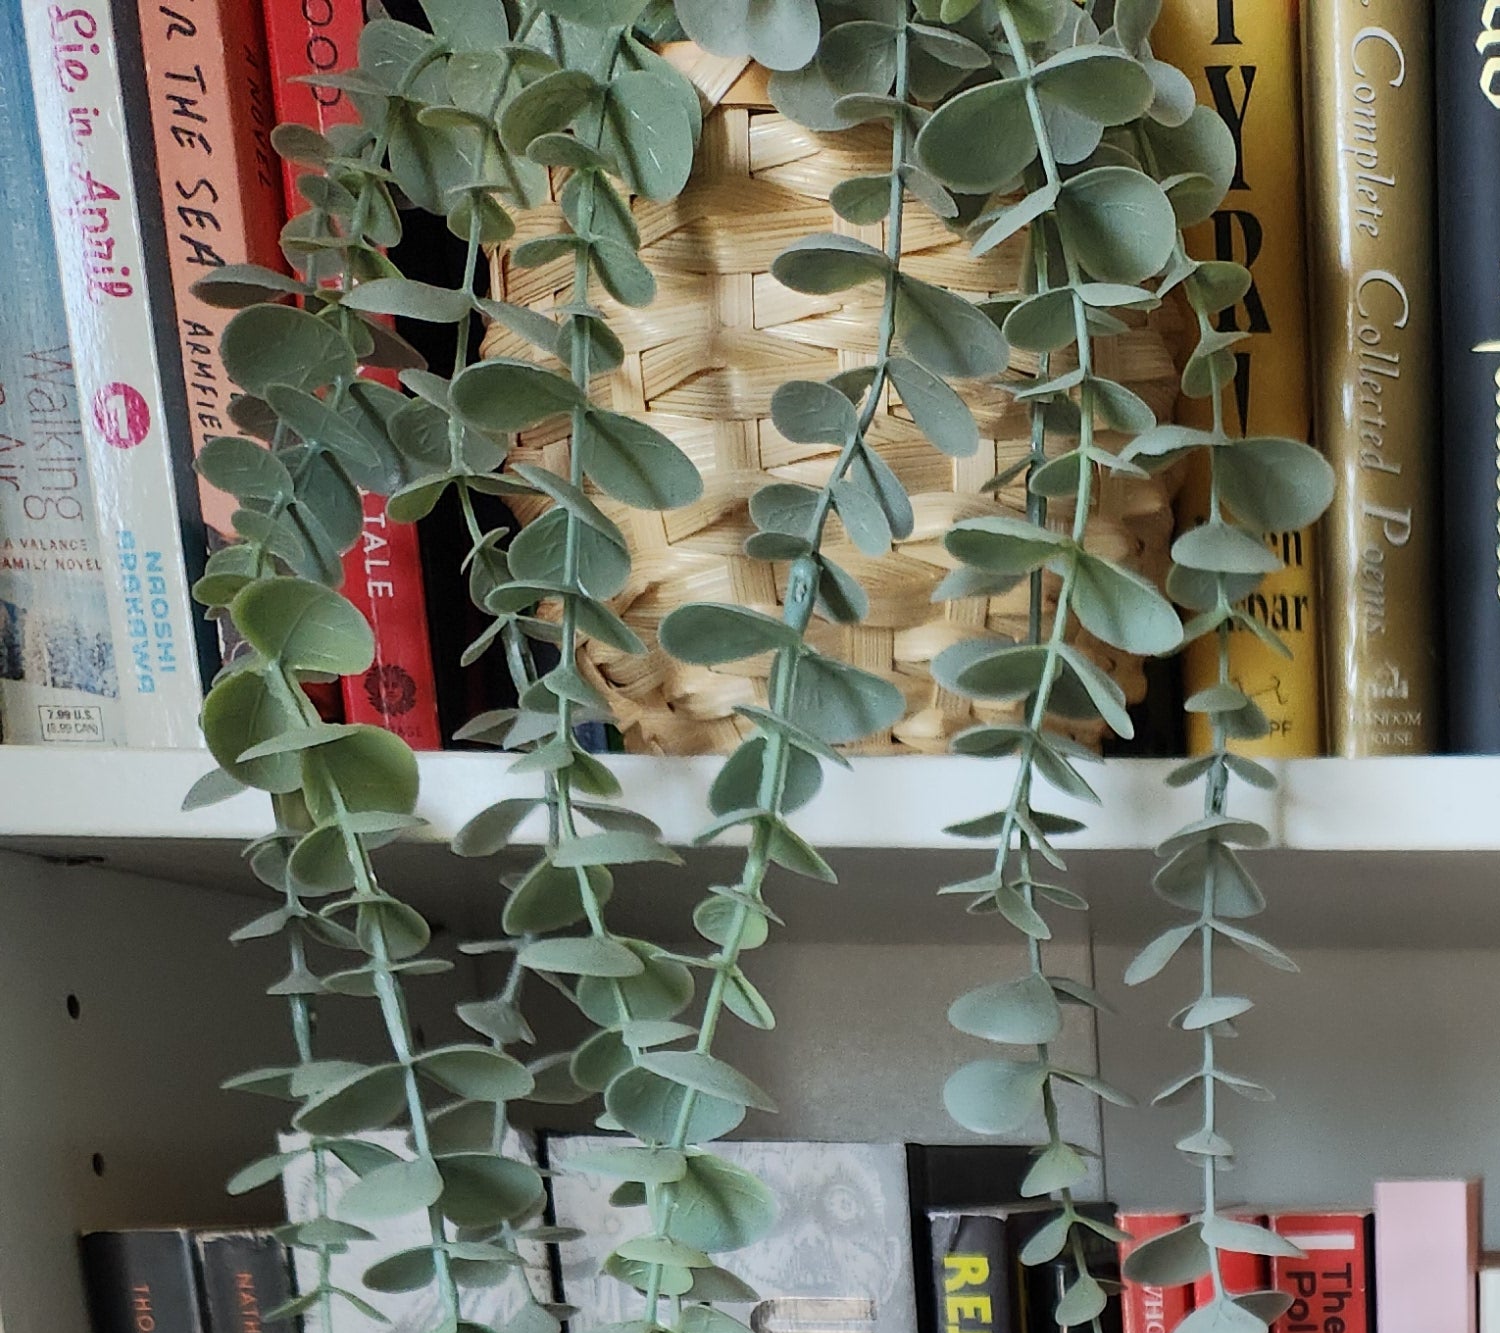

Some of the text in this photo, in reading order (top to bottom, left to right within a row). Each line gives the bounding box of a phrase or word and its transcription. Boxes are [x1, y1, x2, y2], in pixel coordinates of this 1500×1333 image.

[47, 4, 101, 94] Lie
[66, 106, 100, 149] in
[163, 64, 213, 157] THE
[174, 176, 228, 268] SEA
[1350, 25, 1413, 637] Complete Collected Poems
[23, 342, 84, 523] Walking
[20, 537, 88, 550] VALANCE
[55, 557, 102, 571] NOVEL
[364, 508, 394, 600] TALE
[144, 551, 177, 673] NAOSHI
